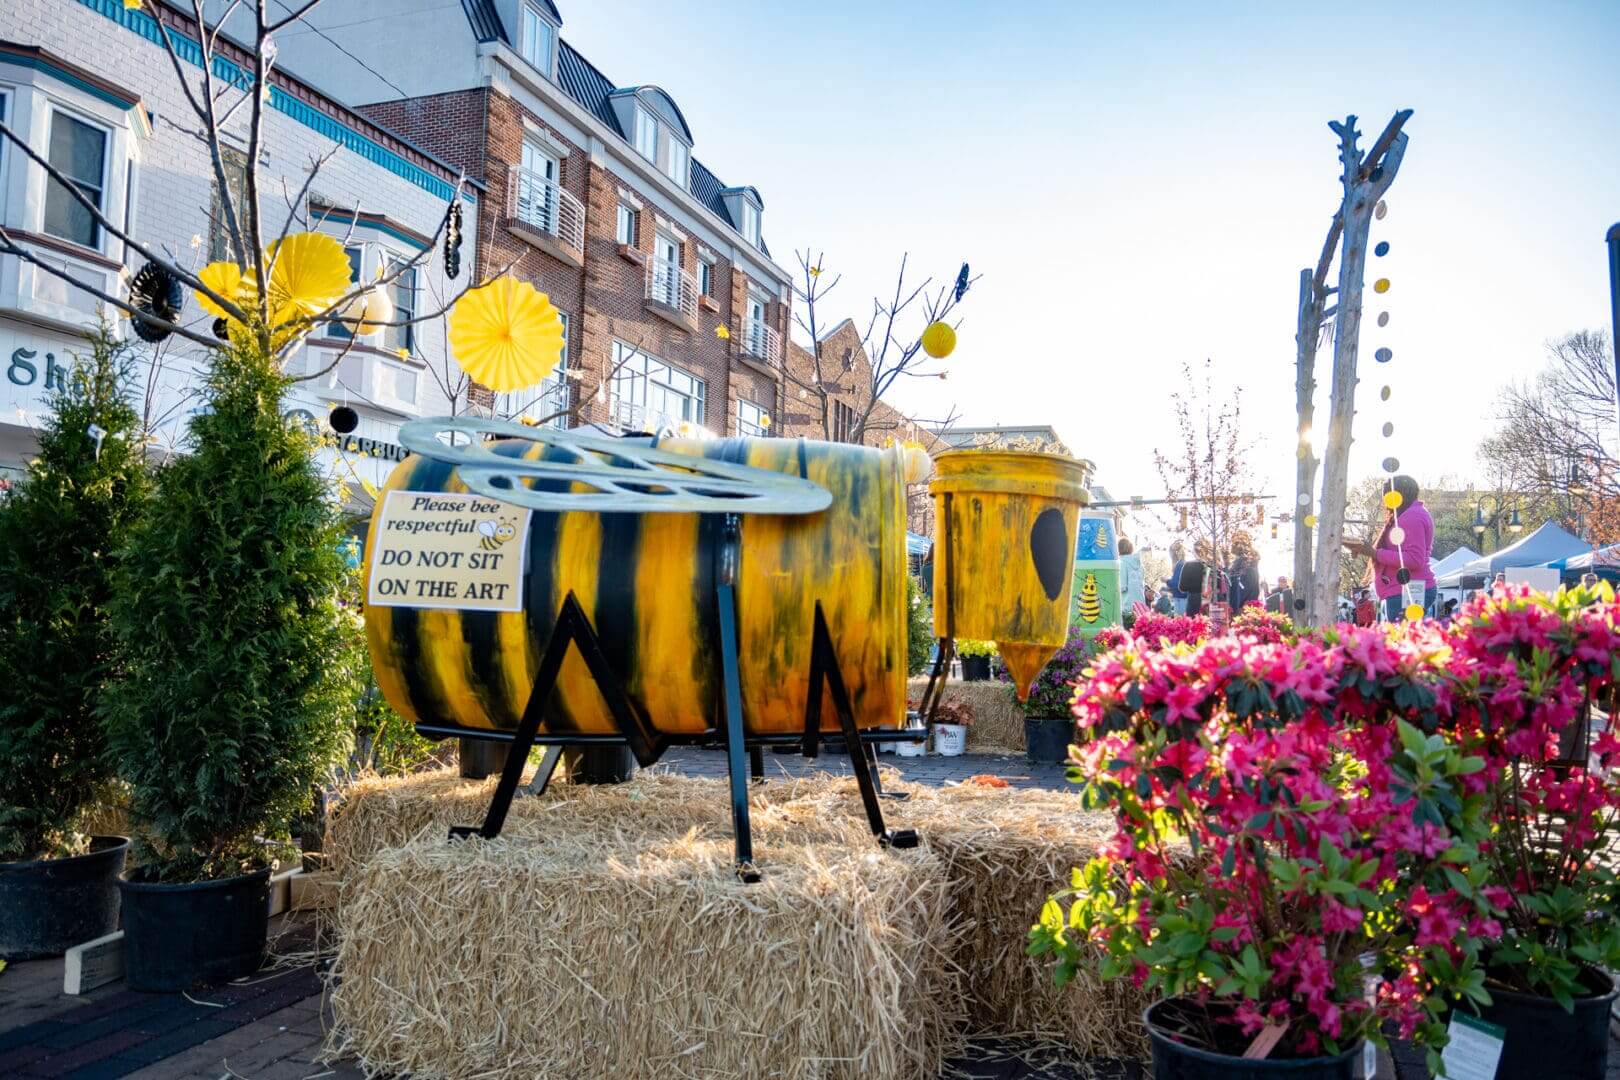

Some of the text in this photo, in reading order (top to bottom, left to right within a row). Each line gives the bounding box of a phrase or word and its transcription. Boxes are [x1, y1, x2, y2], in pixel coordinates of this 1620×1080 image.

[323, 431, 410, 462] TARBUC
[411, 497, 500, 514] Please bee
[387, 518, 476, 535] respectful
[381, 549, 503, 570] DO NOT SIT
[378, 578, 509, 600] ON THE ART
